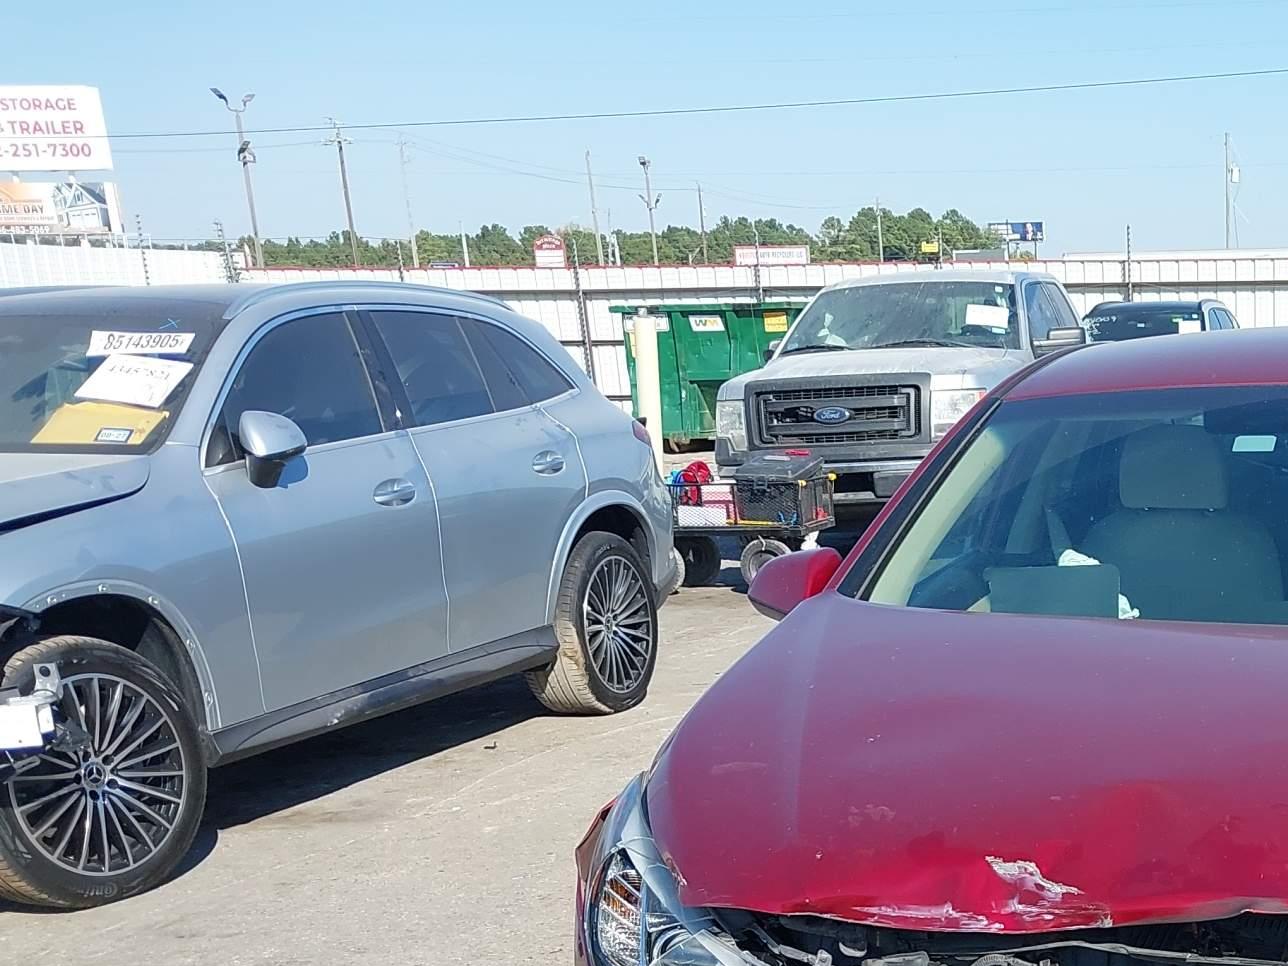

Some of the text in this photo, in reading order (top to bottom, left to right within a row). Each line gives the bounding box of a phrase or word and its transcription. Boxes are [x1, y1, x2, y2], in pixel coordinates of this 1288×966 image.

[0, 97, 77, 111] STORAGE
[7, 120, 85, 135] TRAILER
[23, 204, 44, 214] DAY
